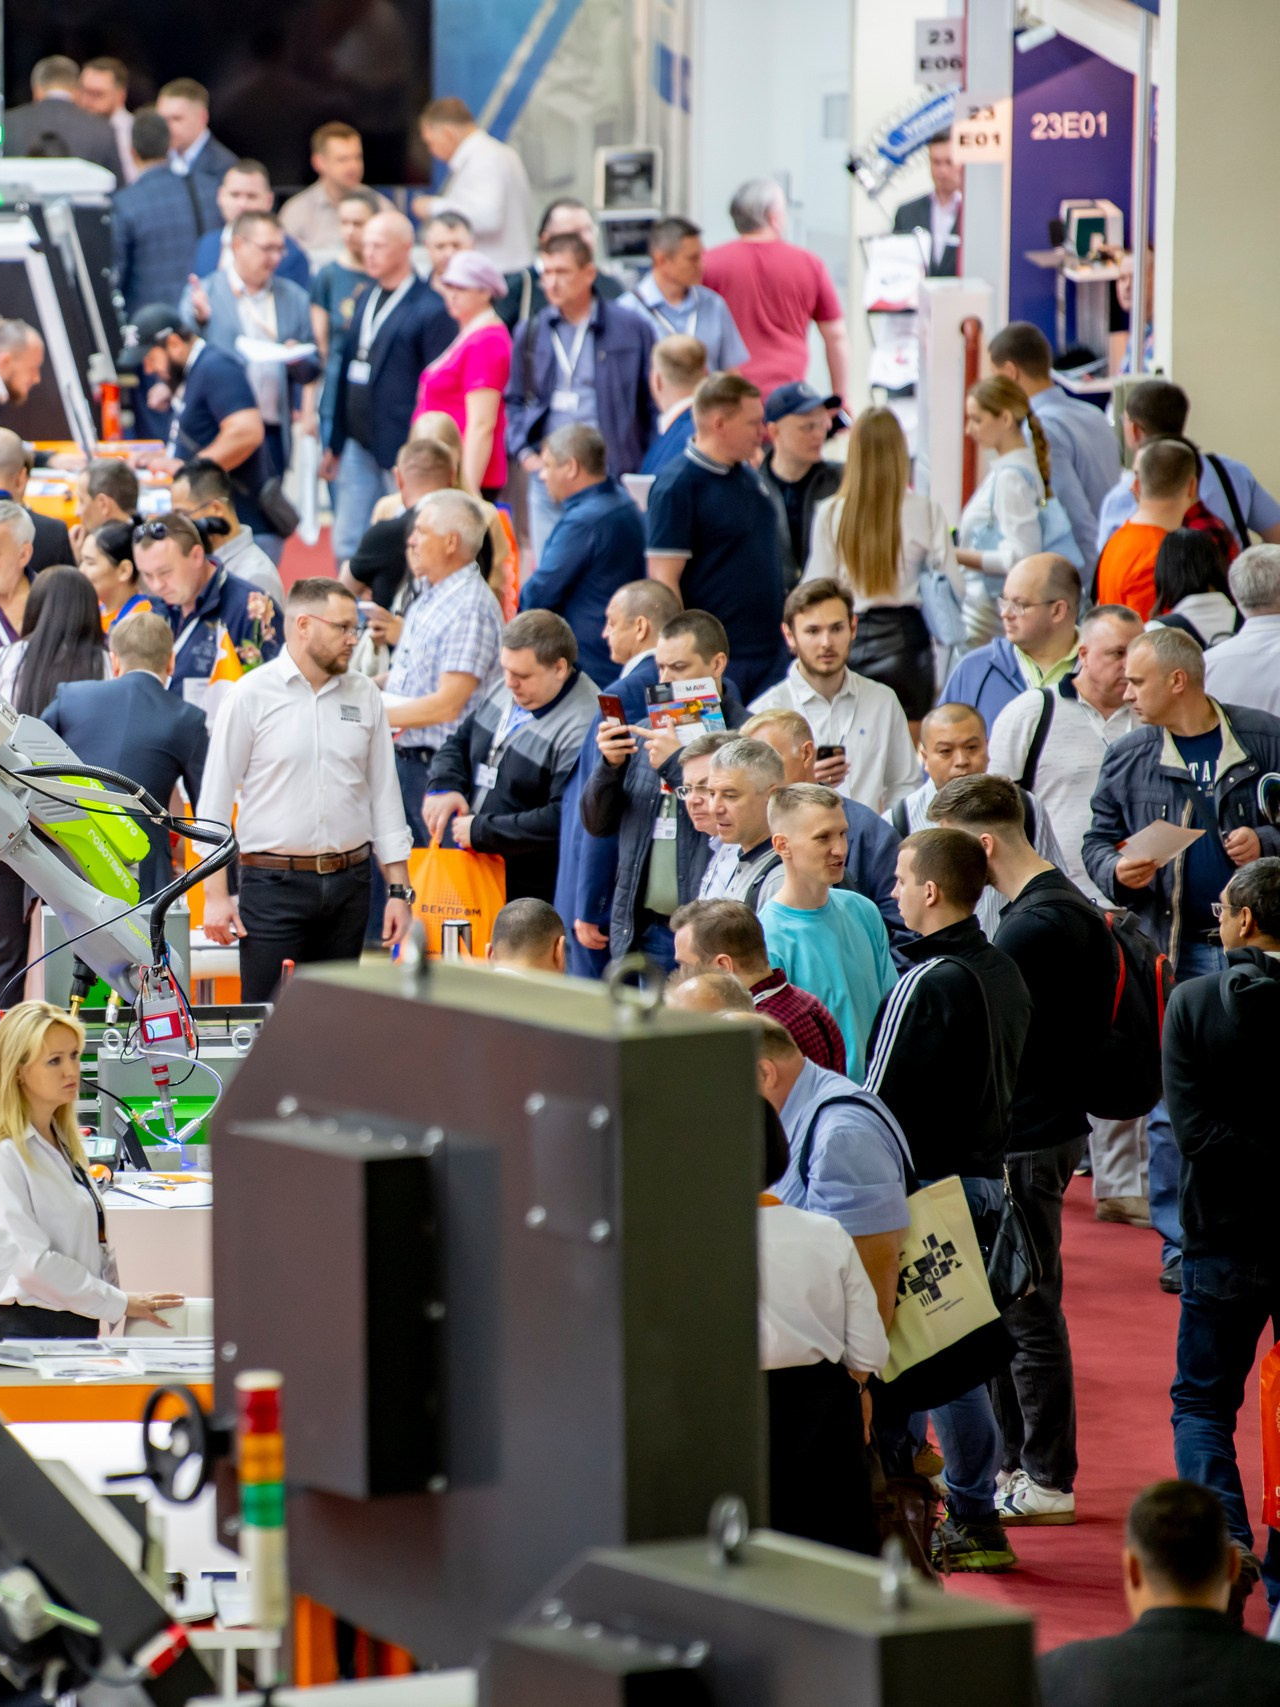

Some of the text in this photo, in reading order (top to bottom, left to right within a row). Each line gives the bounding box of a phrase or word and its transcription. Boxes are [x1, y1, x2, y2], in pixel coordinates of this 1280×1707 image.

[928, 29, 955, 45] 23
[967, 105, 996, 120] 23
[1030, 110, 1108, 140] 23E01
[959, 133, 1001, 146] E01
[421, 904, 482, 917] ВЕКПРОМ
